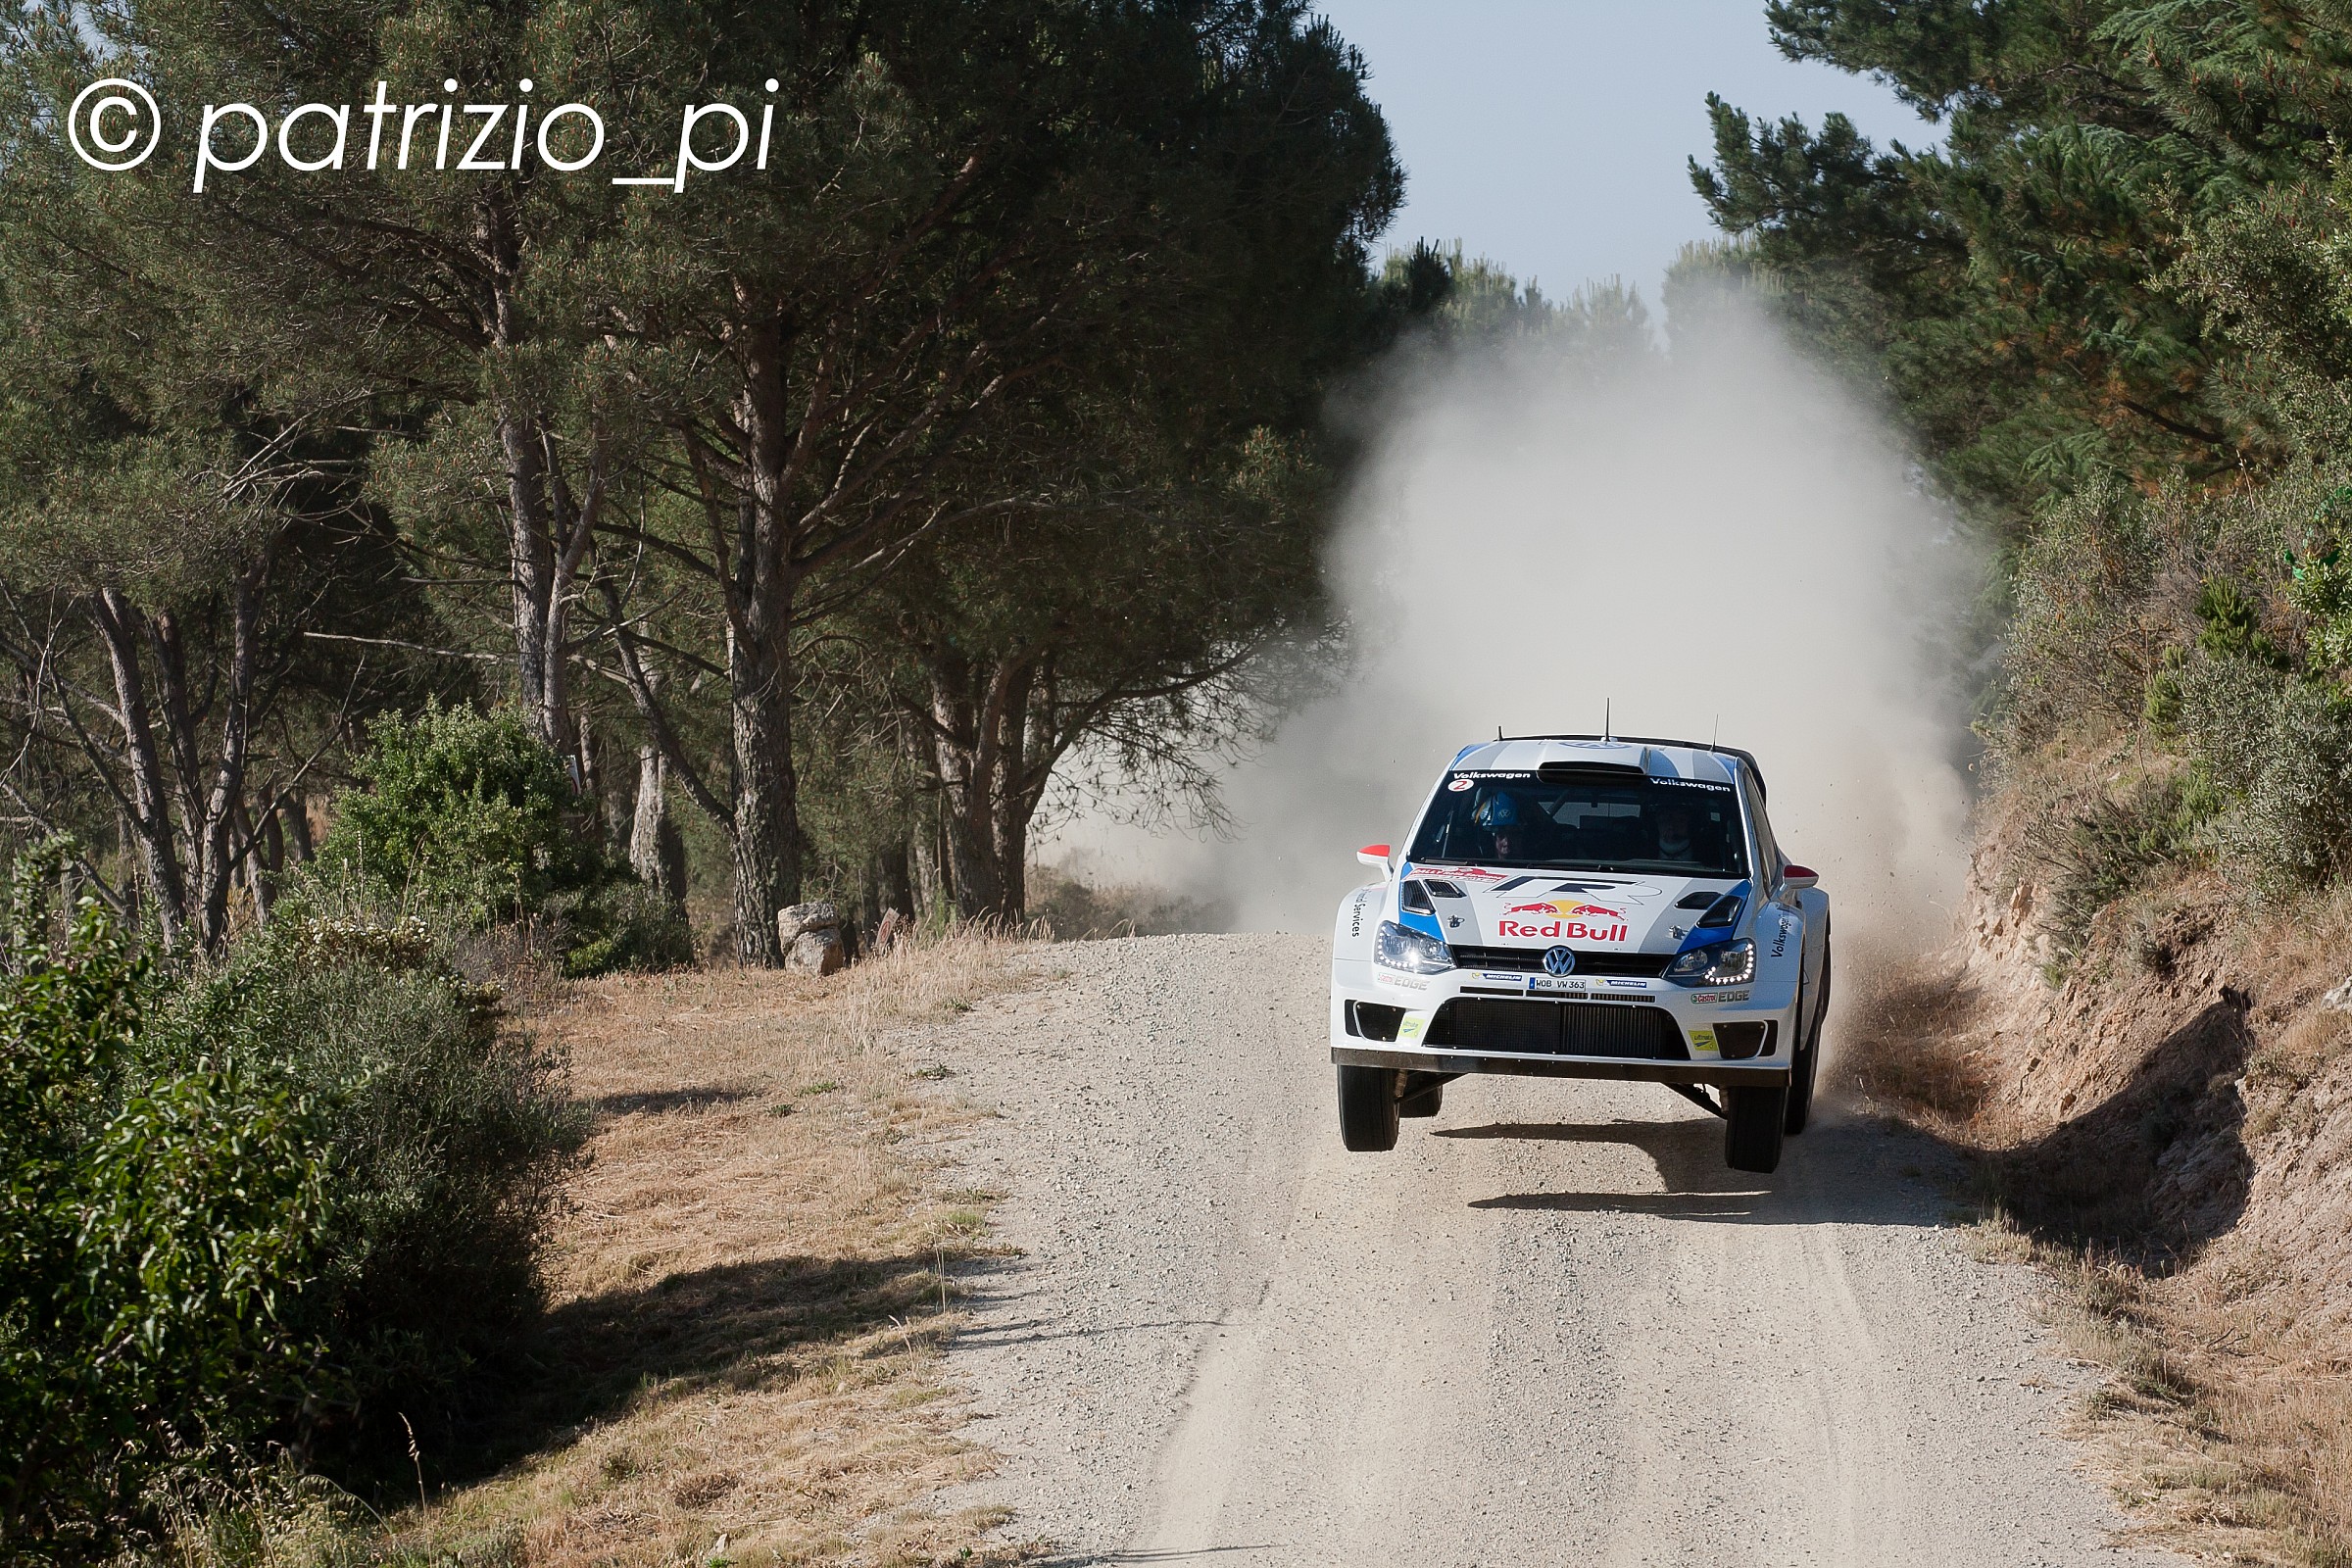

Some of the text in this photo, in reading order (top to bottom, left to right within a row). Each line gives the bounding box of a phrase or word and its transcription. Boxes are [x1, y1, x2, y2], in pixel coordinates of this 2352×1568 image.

[1453, 780, 1468, 791] 2
[1650, 777, 1732, 793] Volkswagen
[1351, 903, 1366, 938] Services
[1498, 920, 1629, 942] Red Bull
[1395, 975, 1430, 992] EDGE
[1485, 973, 1522, 982] MICHELIN
[1536, 979, 1552, 988] WOB
[1556, 980, 1568, 989] VW
[1610, 980, 1647, 989] MICHELIN
[1718, 990, 1750, 1003] EDGE
